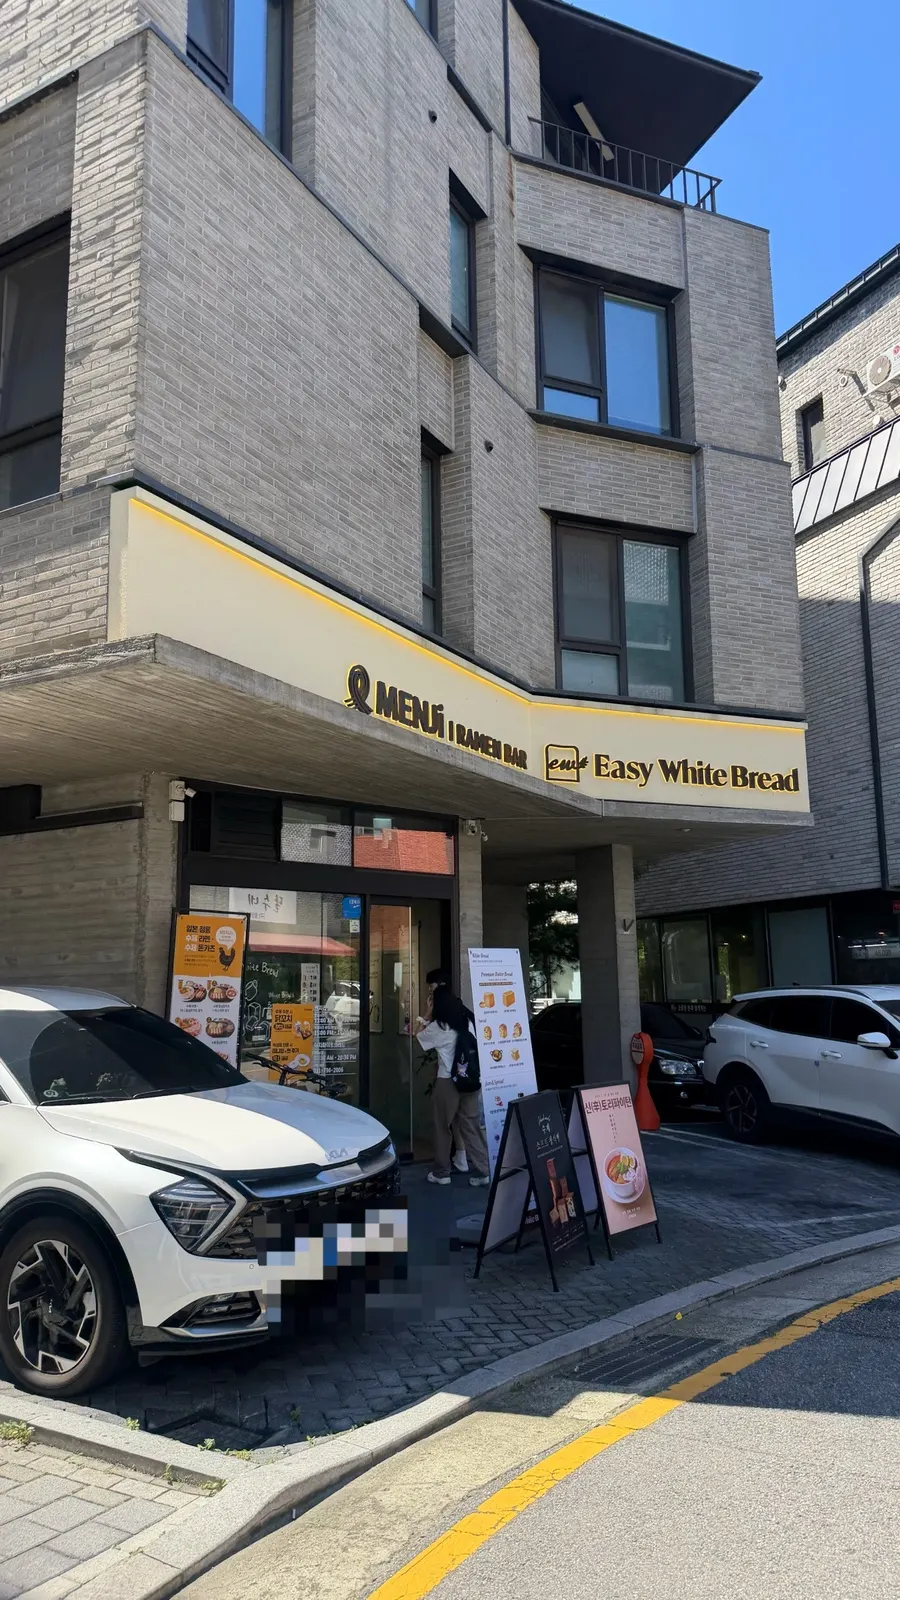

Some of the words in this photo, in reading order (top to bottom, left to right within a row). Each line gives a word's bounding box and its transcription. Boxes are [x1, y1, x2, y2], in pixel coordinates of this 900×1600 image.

[456, 724, 501, 760] RAMEN
[503, 743, 527, 769] BAR
[595, 754, 654, 787] Easy
[658, 759, 727, 786] White
[731, 765, 799, 792] Bread
[199, 935, 210, 943] 라멘
[185, 944, 197, 952] 수제
[198, 944, 215, 952] 돈카츠
[275, 1014, 292, 1022] 닭꼬치
